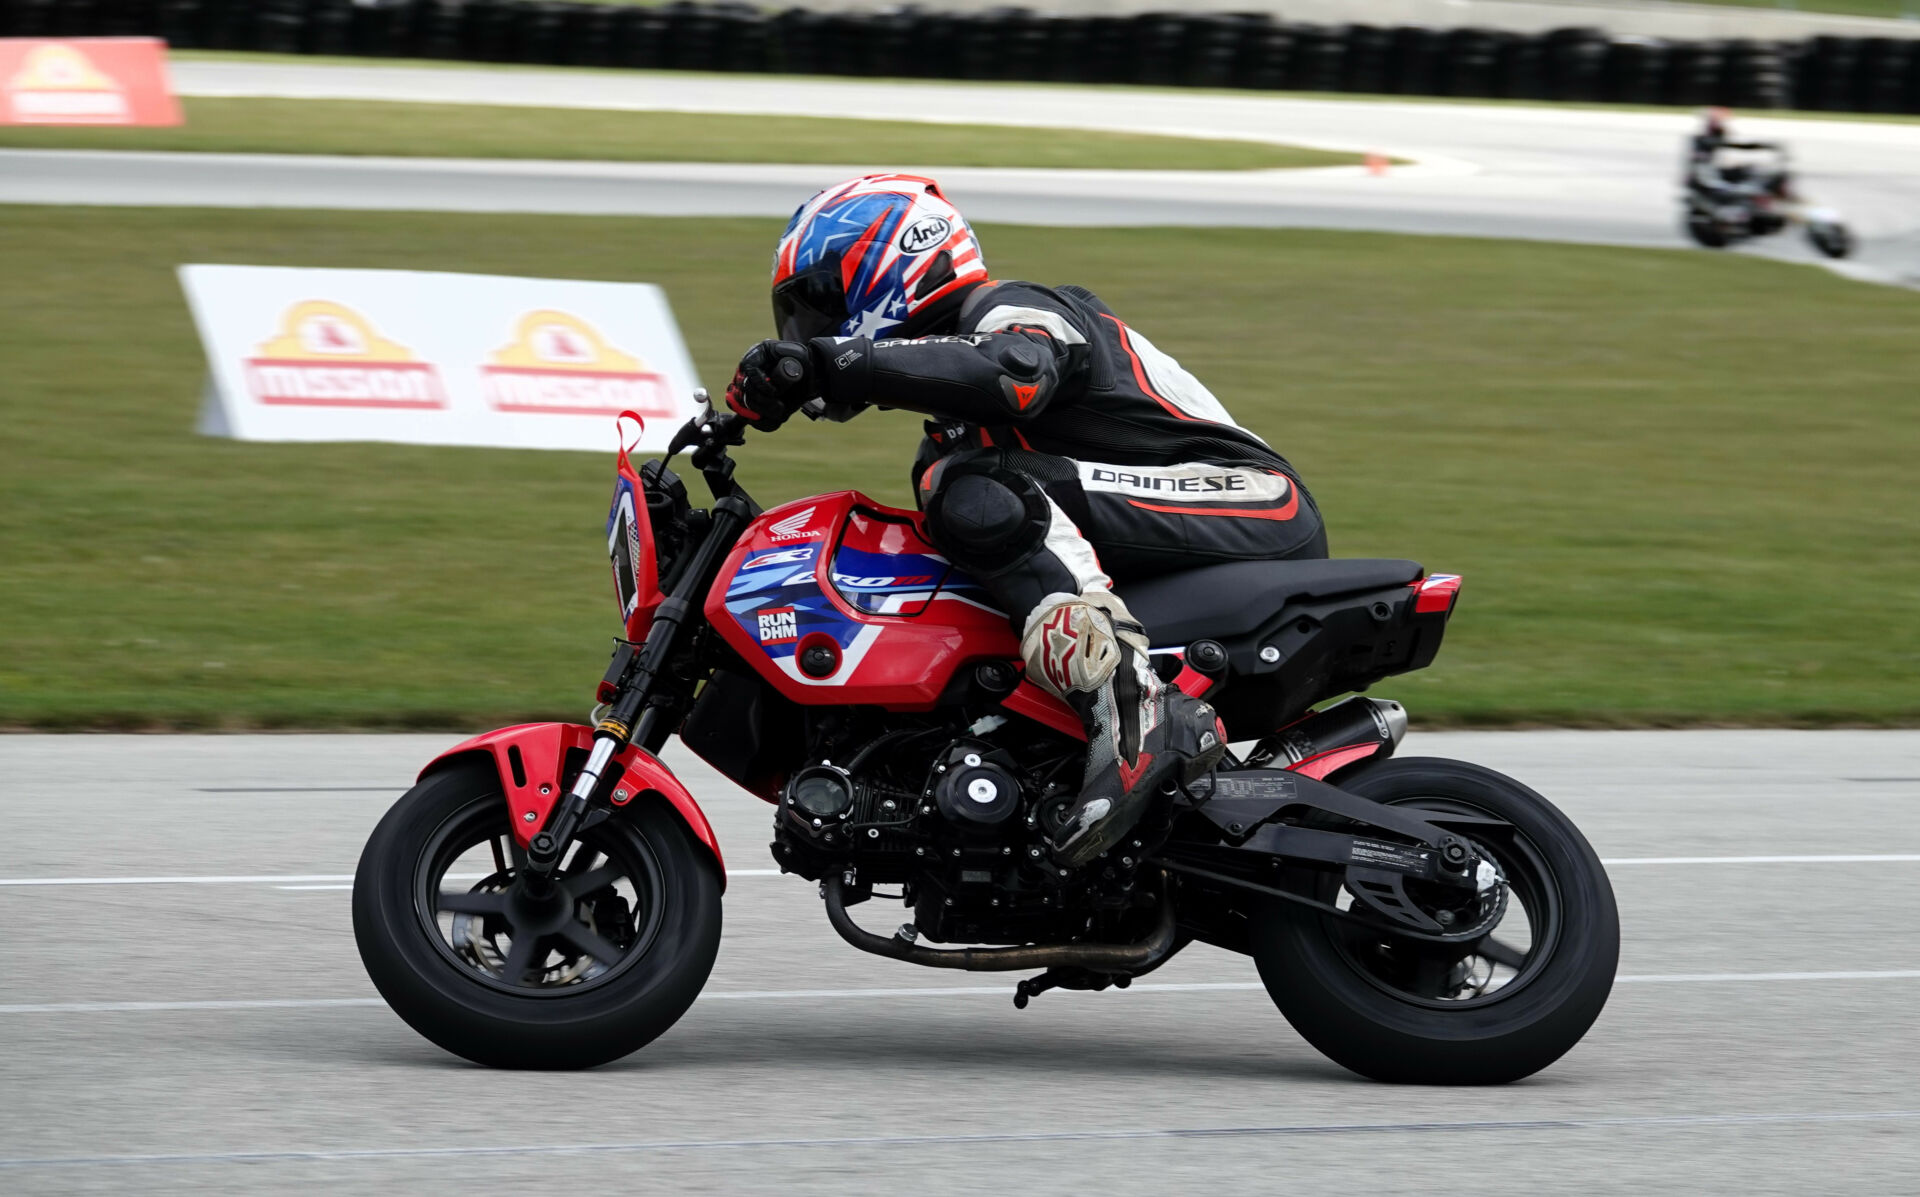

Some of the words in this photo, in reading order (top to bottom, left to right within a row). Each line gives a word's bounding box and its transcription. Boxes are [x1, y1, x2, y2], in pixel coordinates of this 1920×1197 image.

[905, 221, 945, 251] Arai
[1092, 468, 1245, 492] DAINESE
[771, 529, 821, 542] HONDA
[758, 612, 796, 628] RUN
[760, 625, 798, 641] DHM
